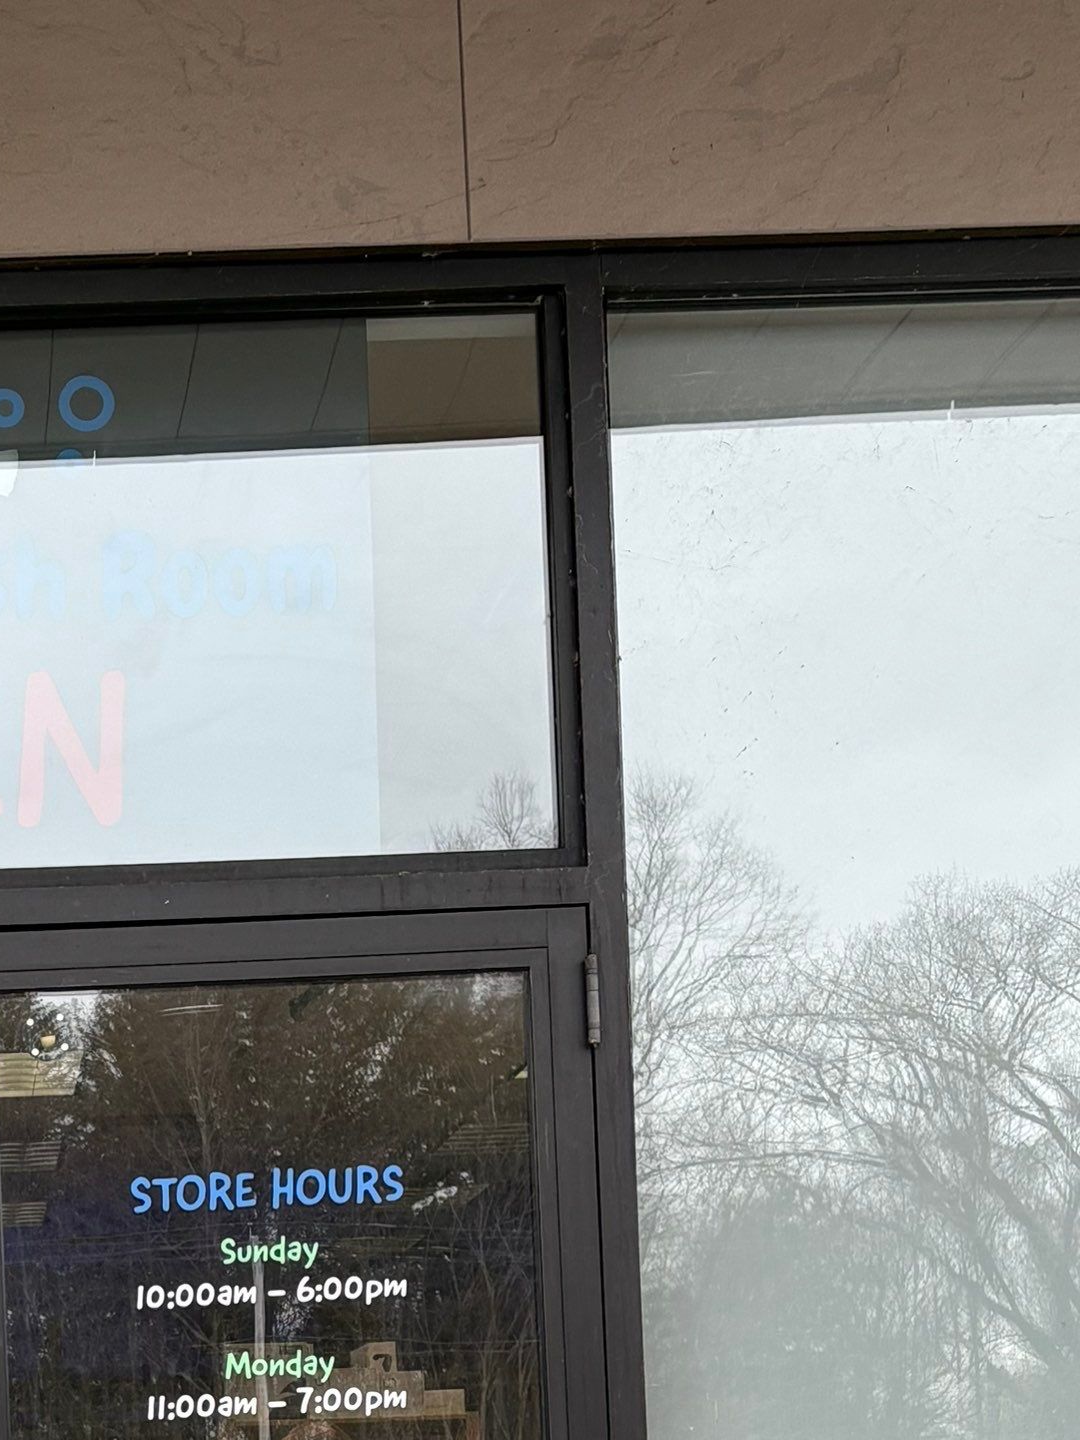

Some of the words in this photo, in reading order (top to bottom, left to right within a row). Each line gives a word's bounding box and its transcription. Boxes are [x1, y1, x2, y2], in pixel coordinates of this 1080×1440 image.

[100, 529, 338, 621] Room
[130, 1171, 257, 1214] STORE
[271, 1165, 405, 1209] HOURS
[220, 1237, 319, 1267] Sunday
[136, 1282, 258, 1311] 10:00am
[296, 1275, 408, 1306] 6:00pm
[224, 1350, 335, 1383] Monday
[146, 1393, 258, 1421] 11:00am
[295, 1386, 408, 1417] 7:00pm
